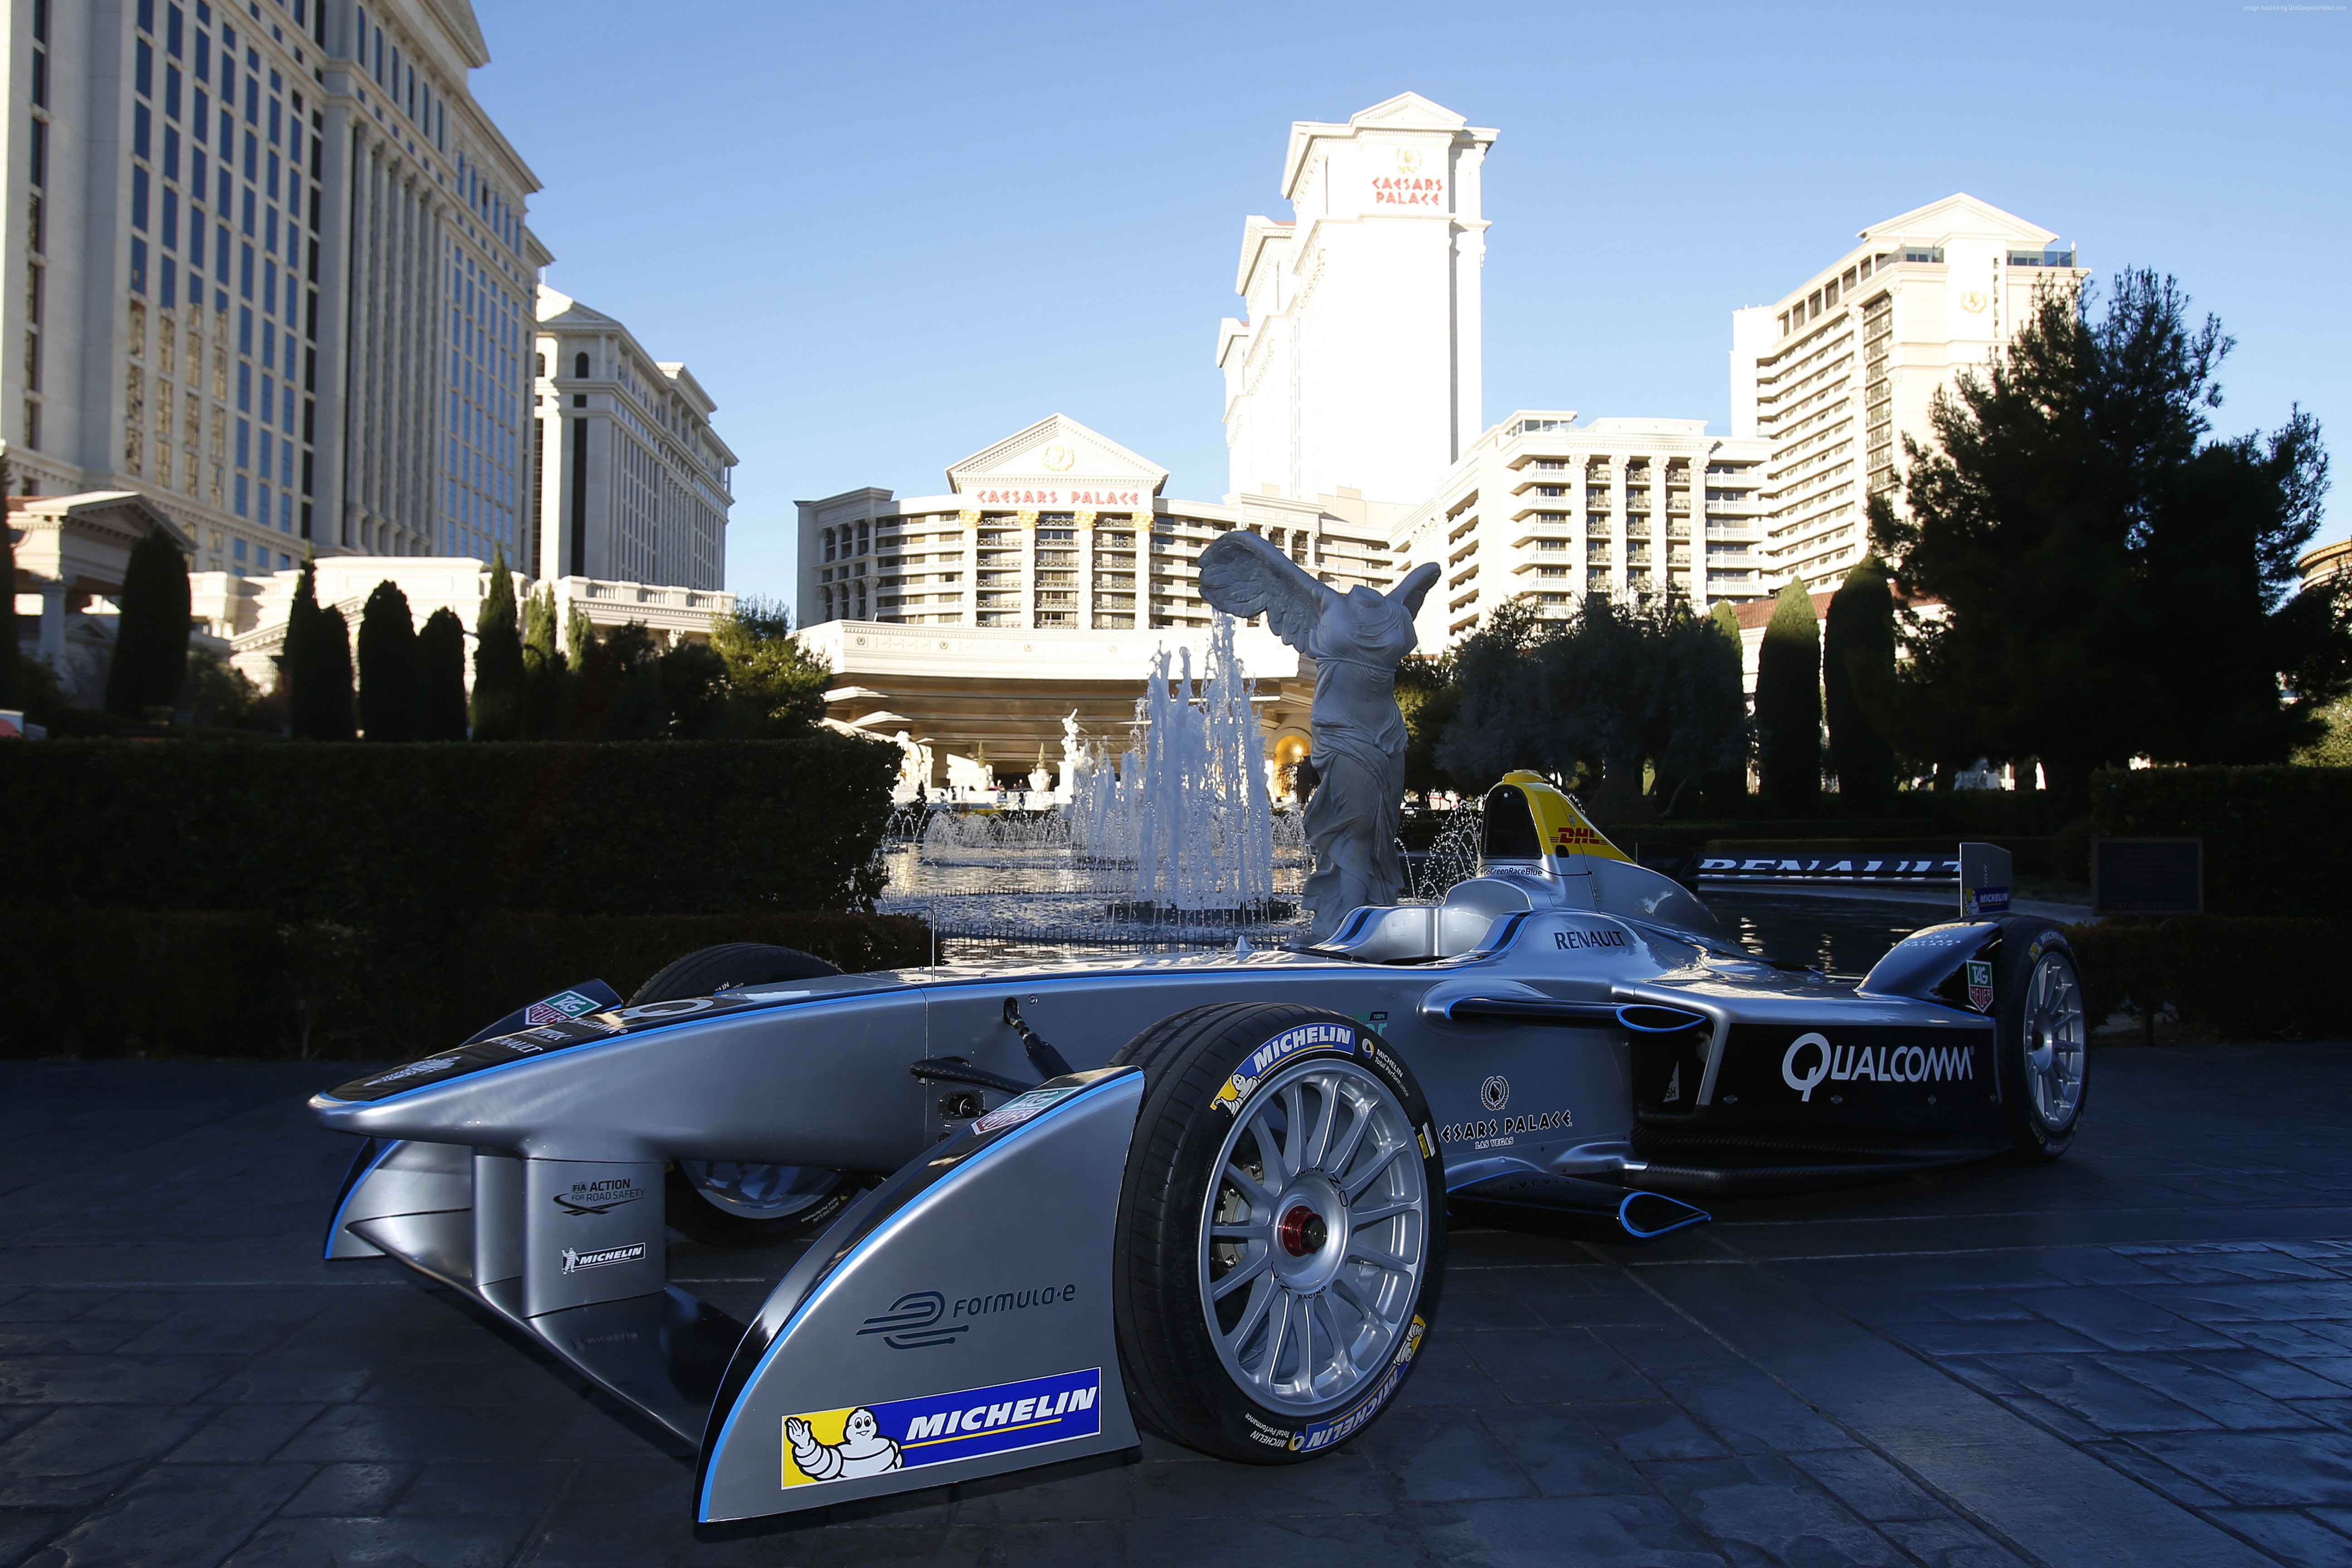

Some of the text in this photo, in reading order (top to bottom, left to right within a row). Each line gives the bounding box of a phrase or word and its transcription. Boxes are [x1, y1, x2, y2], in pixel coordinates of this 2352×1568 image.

[1372, 177, 1443, 191] CAESARS
[1377, 191, 1439, 206] PALACE
[977, 490, 1139, 505] CAESARS PALACE
[1558, 827, 1600, 844] DHL
[1980, 893, 2008, 904] MICHELIN
[1553, 931, 1626, 950] RENAULT
[1972, 966, 1988, 985] TAG
[553, 995, 587, 1012] TAG
[1971, 988, 1992, 1008] HEUER
[1253, 1027, 1351, 1073] MICHELIN
[1377, 1049, 1403, 1078] MICHELIN
[1782, 1033, 1972, 1102] QUALCOMM
[1375, 1057, 1409, 1097] Total Performance
[1436, 1119, 1498, 1142] ESARS
[1504, 1110, 1571, 1135] PALACE
[1475, 1137, 1514, 1149] LAS VEGAS
[573, 1179, 630, 1192] FIA ACTION
[587, 1192, 611, 1201] ROAD
[613, 1188, 646, 1199] SAFETY
[579, 1247, 642, 1264] MICHELIN
[1298, 1285, 1326, 1299] RACING
[905, 1387, 1097, 1441] MICHELIN
[1306, 1369, 1397, 1448] MICHELIN
[1245, 1412, 1290, 1438] Total Performance
[1250, 1430, 1287, 1447] MICHELIN
